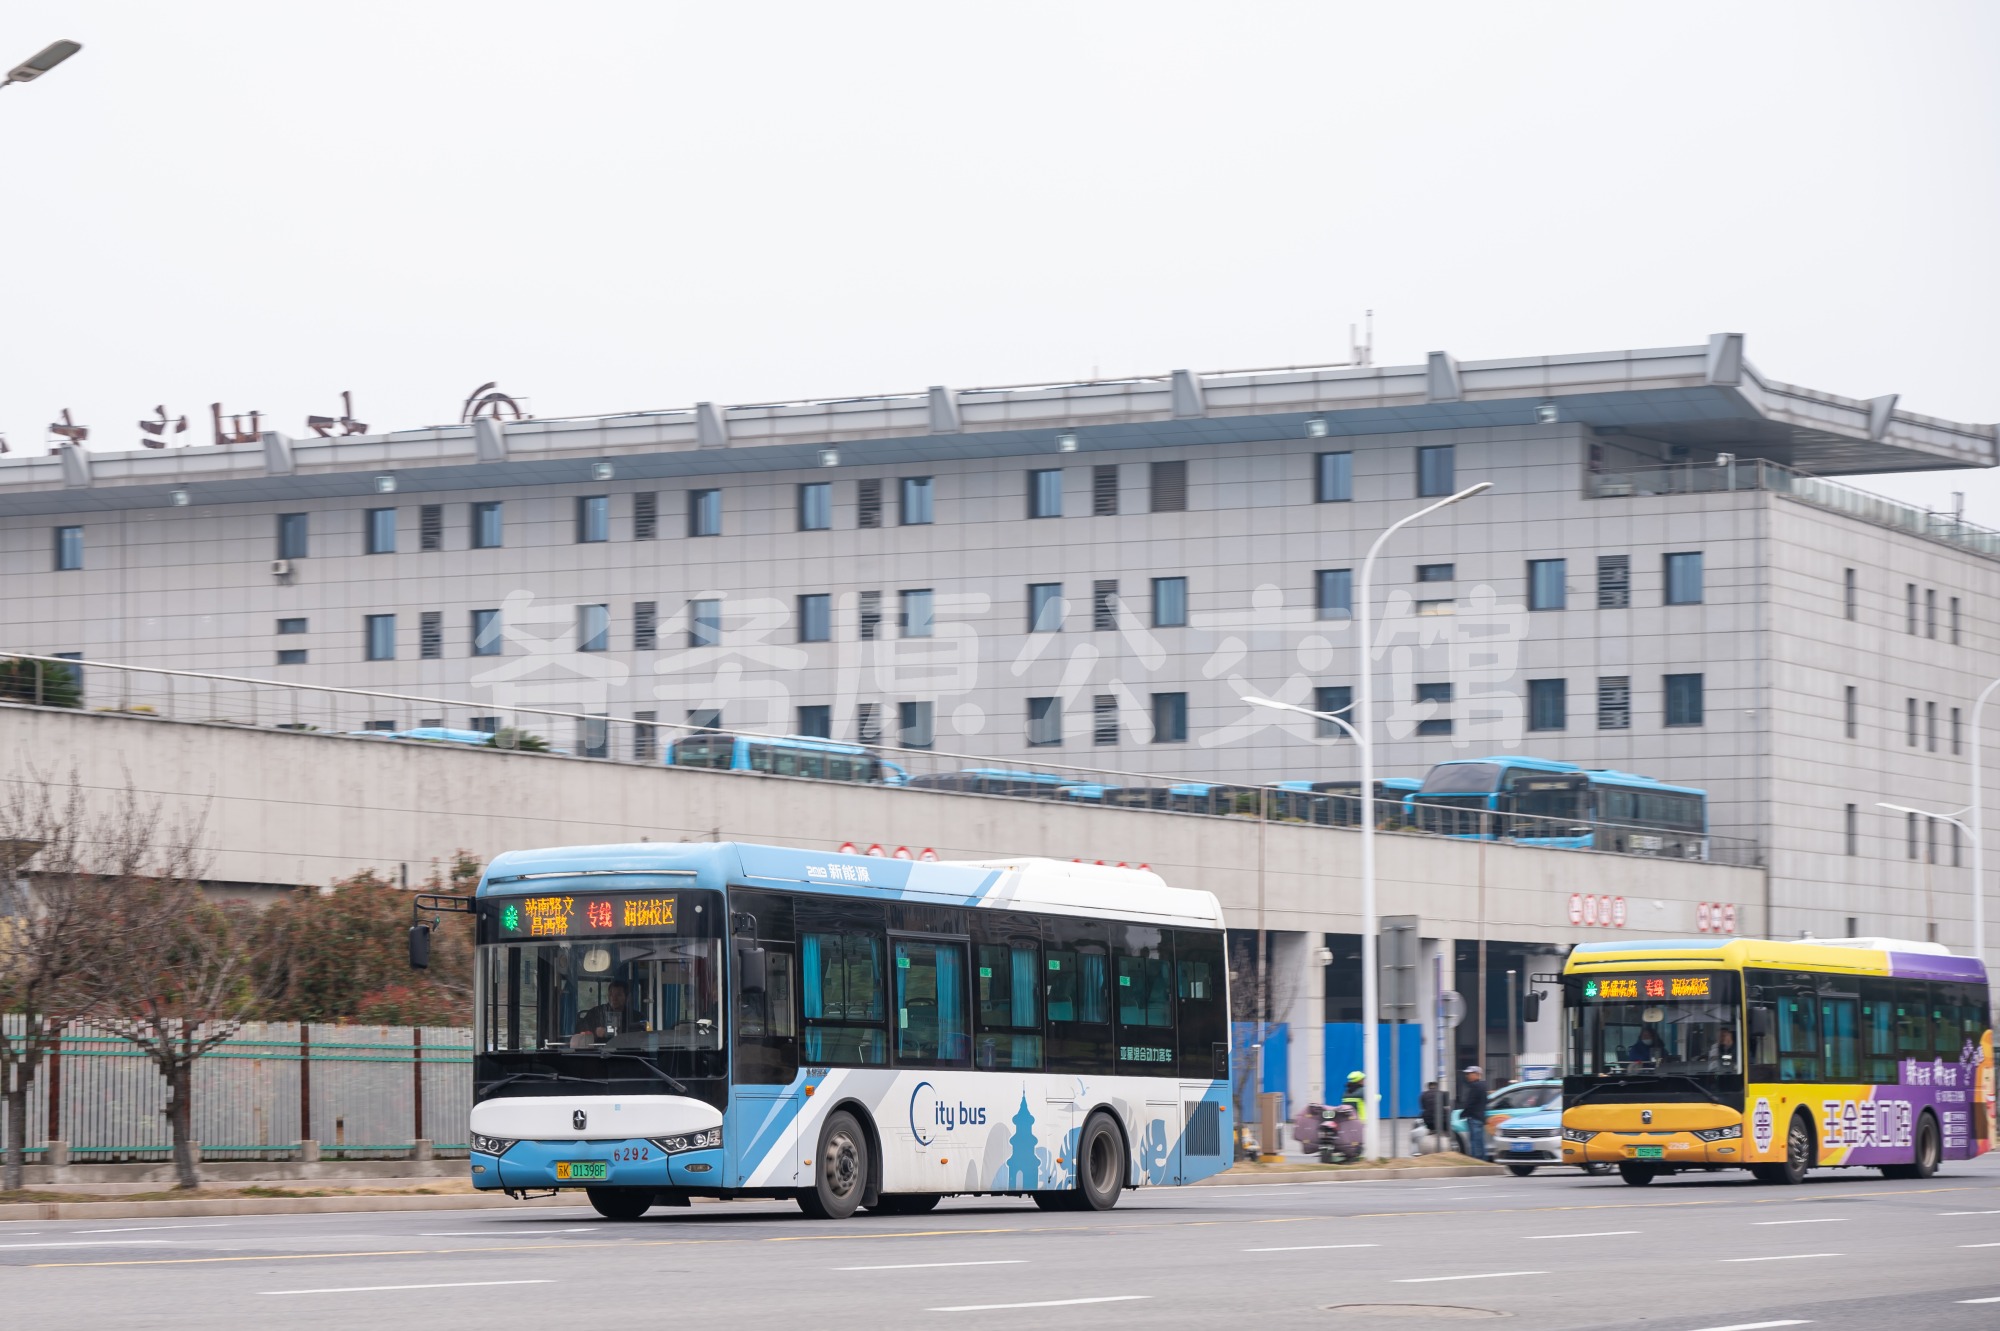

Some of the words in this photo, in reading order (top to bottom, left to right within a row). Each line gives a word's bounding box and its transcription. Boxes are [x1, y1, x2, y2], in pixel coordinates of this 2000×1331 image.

[828, 863, 871, 883] 新能源
[525, 896, 575, 917] 站南路文
[587, 902, 613, 929] 专线
[624, 898, 675, 927] 润扬校区
[531, 915, 569, 936] 昌西路
[1645, 978, 1666, 997] 专线
[1120, 1046, 1172, 1062] 亚星混合动力客车
[909, 1081, 955, 1147] City
[959, 1101, 987, 1125] bus
[1822, 1100, 1912, 1148] 王金美口腔
[613, 1147, 649, 1162] 6292
